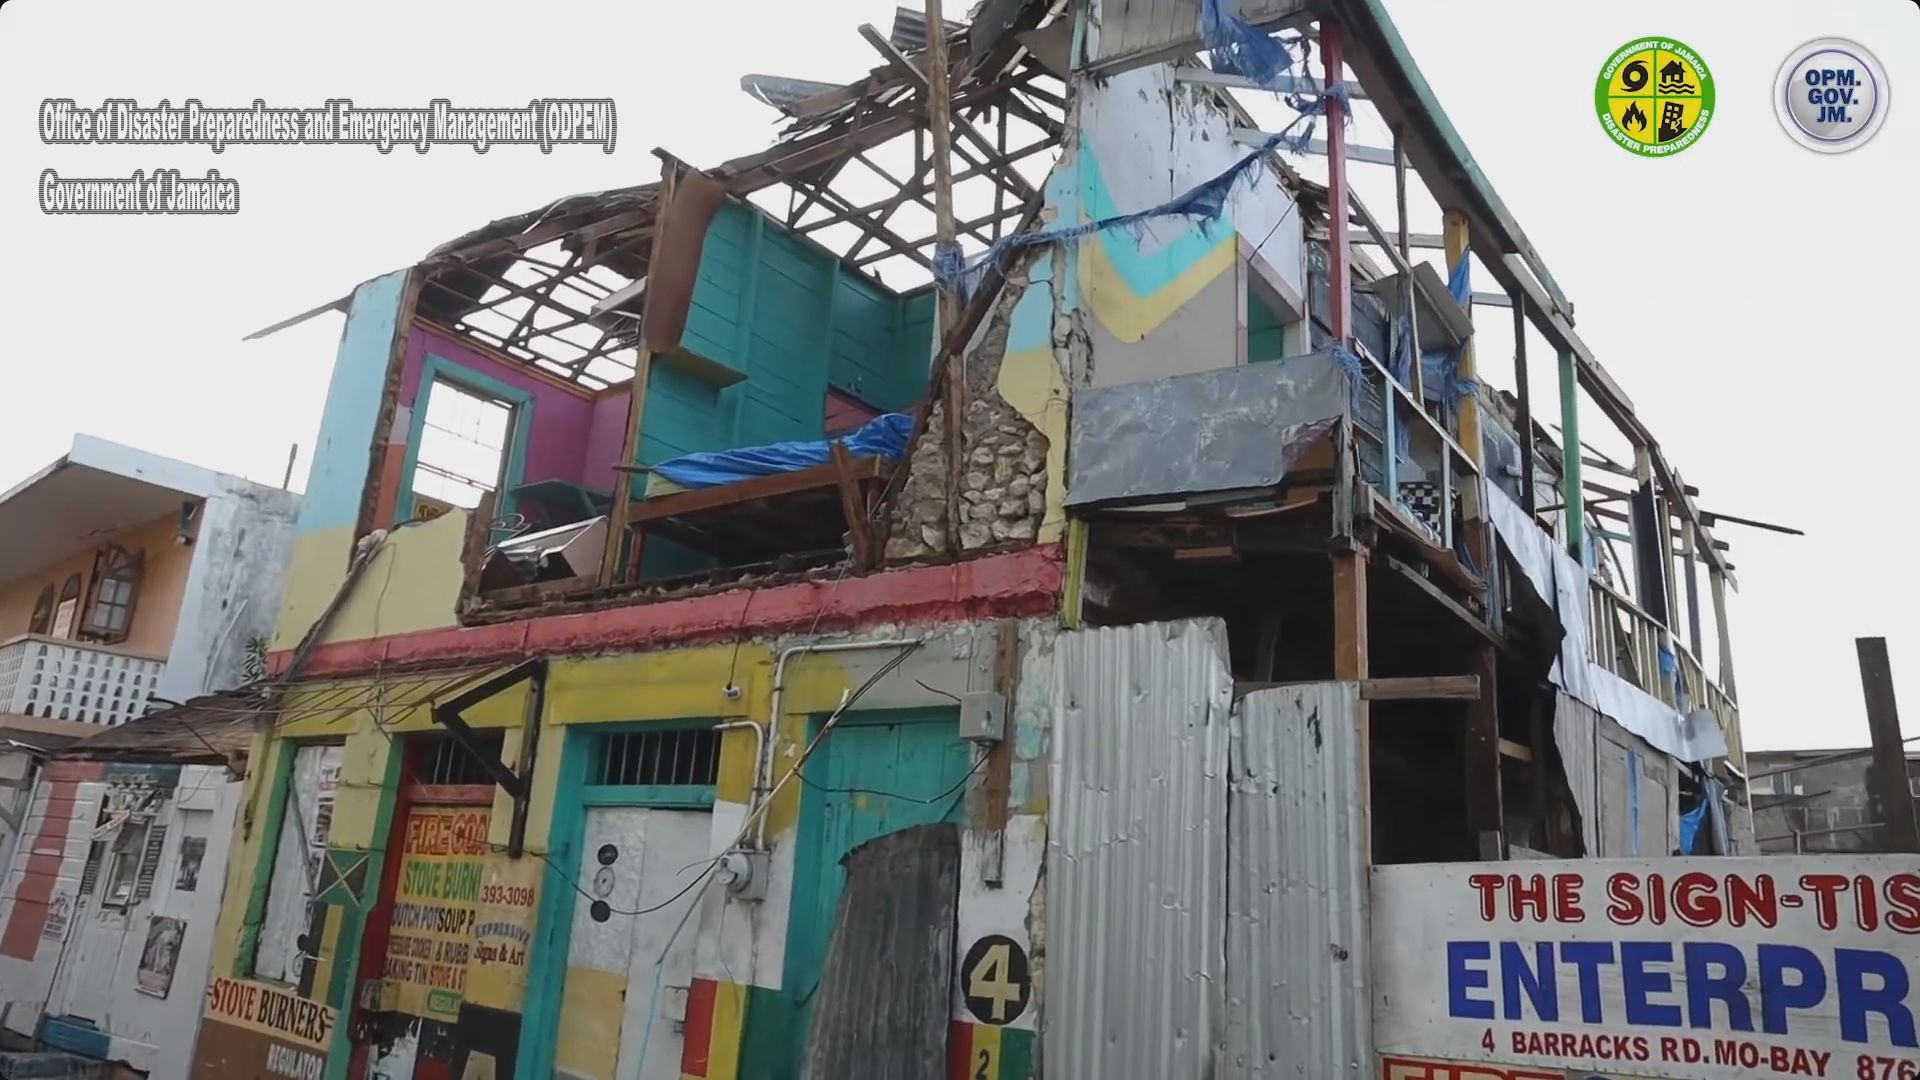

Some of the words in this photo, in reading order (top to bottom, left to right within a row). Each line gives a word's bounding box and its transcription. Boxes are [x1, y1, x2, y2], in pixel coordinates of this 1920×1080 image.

[405, 814, 452, 856] FIRE
[403, 861, 442, 897] STOVE
[482, 885, 535, 908] 393-3098
[437, 907, 467, 934] SOUP
[1468, 873, 1585, 923] THE
[1605, 871, 1920, 935] SIGN-TIS
[499, 942, 508, 962] &
[508, 945, 525, 966] Art
[969, 944, 1020, 1020] 4
[1446, 941, 1920, 1048] ENTERPR
[210, 978, 257, 1020] STOVE
[257, 989, 328, 1043] BURNERS
[1481, 1028, 1495, 1053] 4
[1511, 1031, 1650, 1061] BARRACKS
